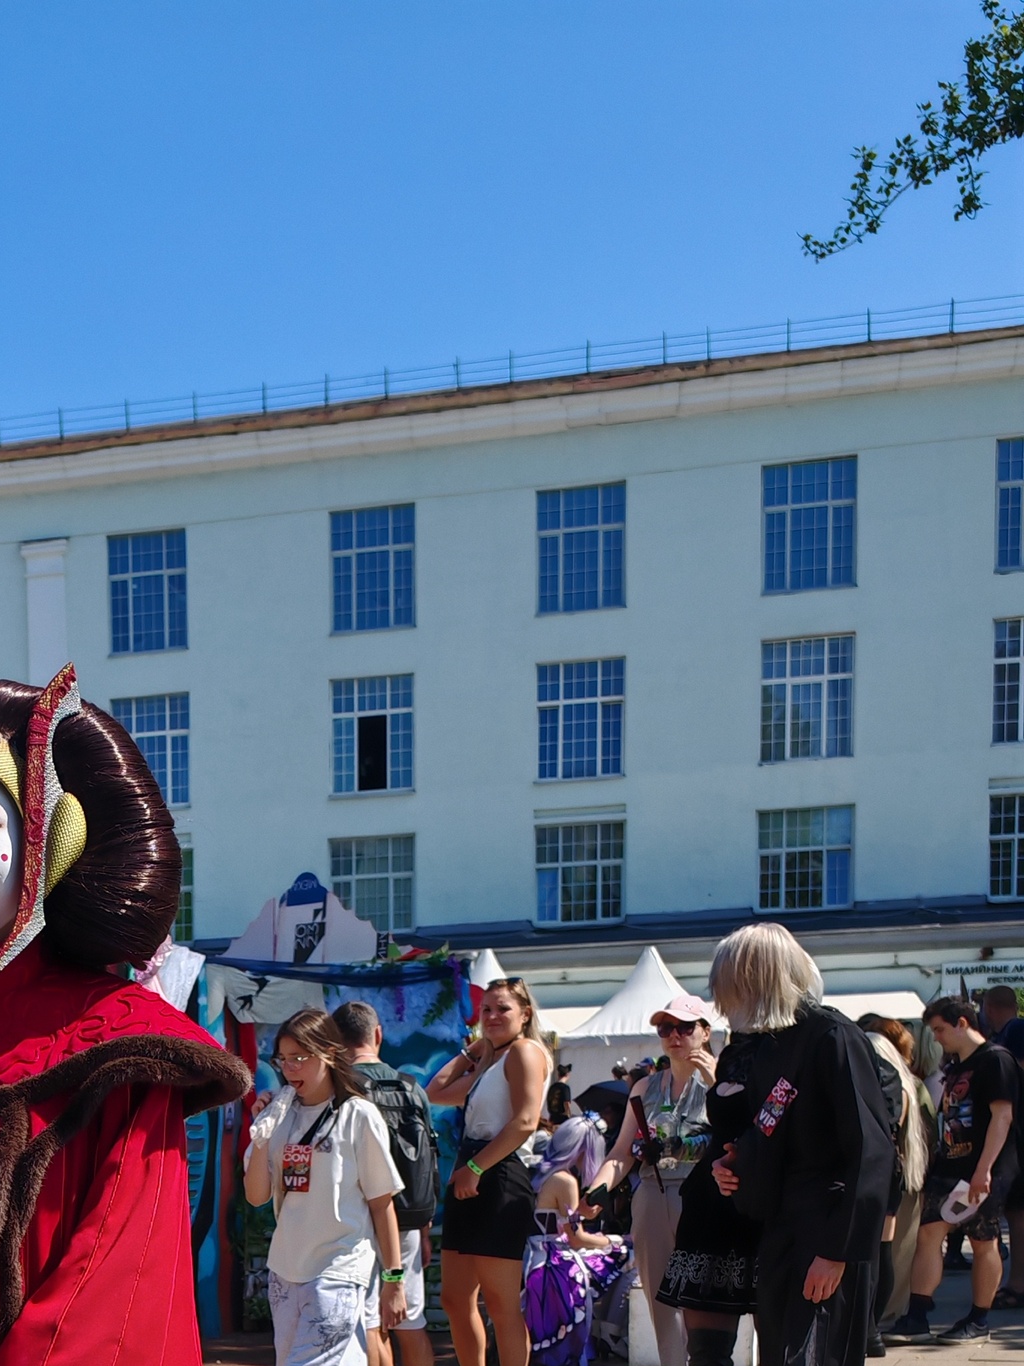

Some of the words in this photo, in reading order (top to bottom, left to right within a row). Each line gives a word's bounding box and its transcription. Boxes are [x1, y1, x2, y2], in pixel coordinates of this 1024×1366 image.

[759, 1108, 776, 1127] VIP
[285, 1144, 312, 1154] EPIC
[283, 1153, 310, 1163] CON
[284, 1176, 307, 1187] VIP
